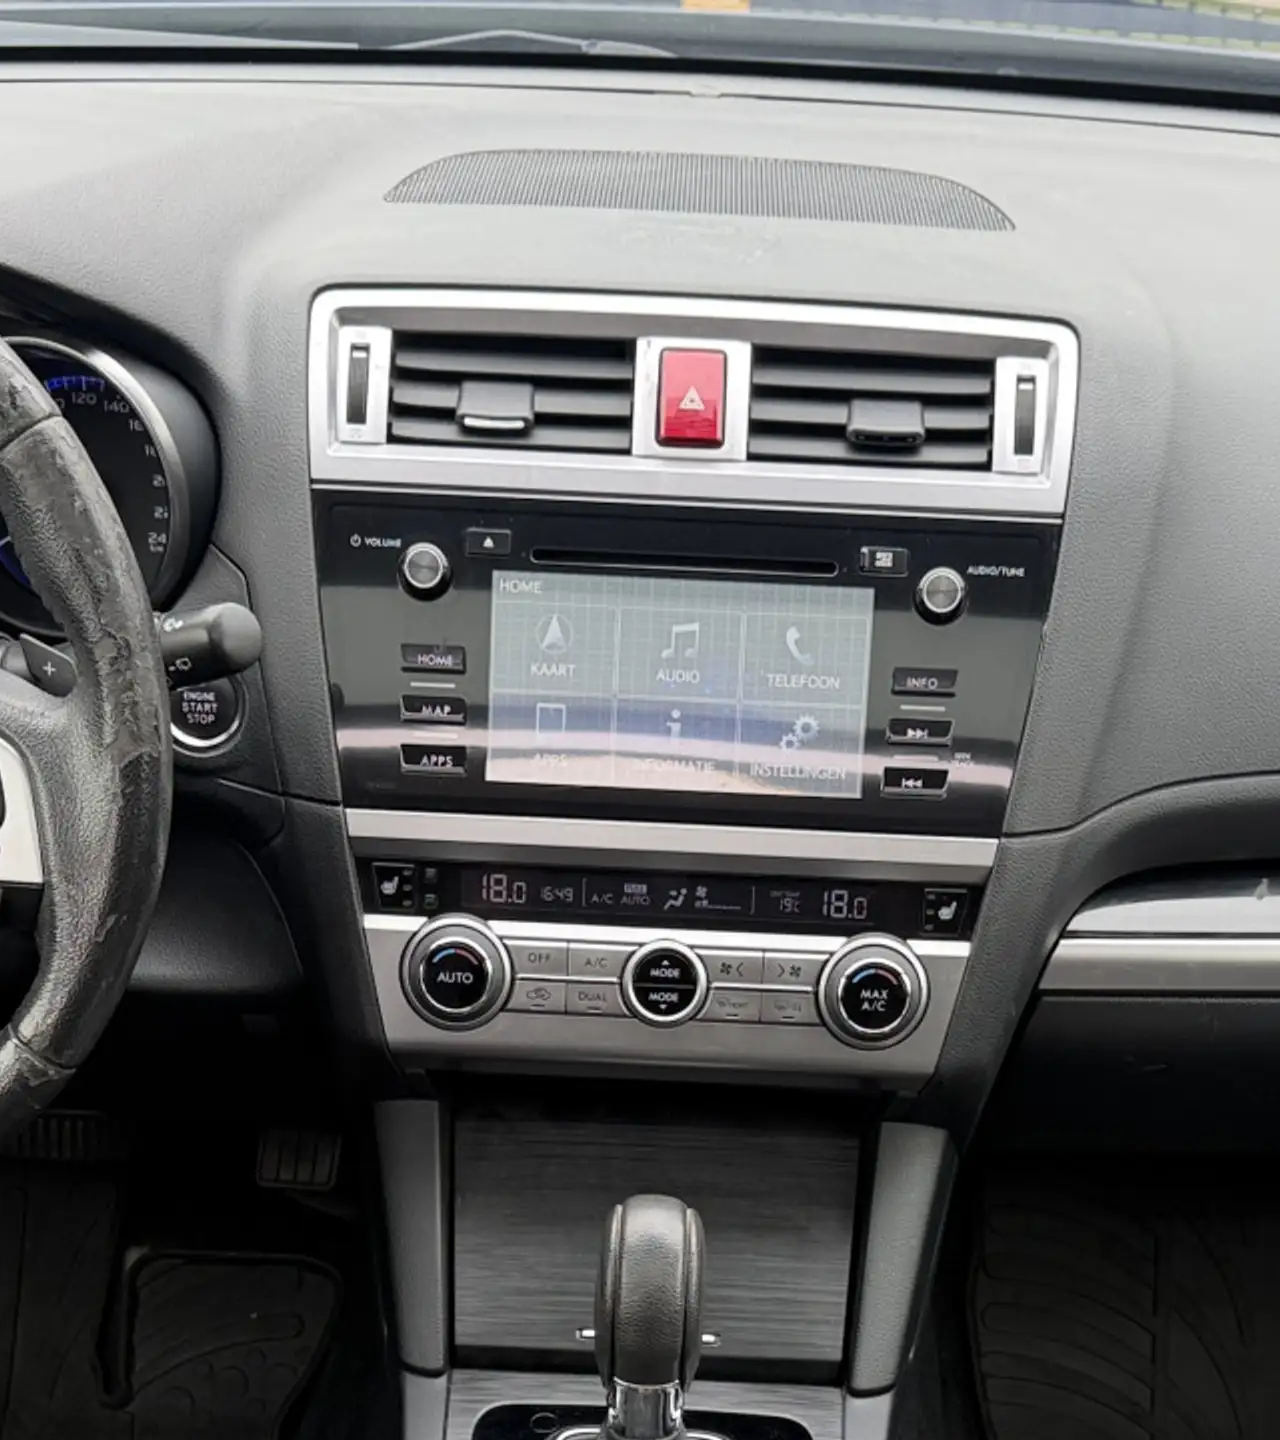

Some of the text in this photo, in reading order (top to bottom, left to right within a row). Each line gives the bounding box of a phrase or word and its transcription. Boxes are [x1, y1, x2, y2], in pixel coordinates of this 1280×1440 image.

[72, 392, 96, 404] 120
[364, 537, 402, 548] VOLUME
[967, 565, 1025, 578] AUDIO/TUNE
[500, 579, 542, 594] HOME
[418, 654, 453, 667] HOME
[530, 663, 576, 678] KAART
[656, 669, 700, 684] AUDIO
[767, 674, 840, 690] TELEFOON
[906, 678, 938, 689] INFO
[183, 690, 215, 701] ENGINE
[182, 702, 218, 714] START
[422, 704, 451, 716] MAP
[186, 714, 216, 725] STOP
[420, 754, 453, 767] APPS
[750, 762, 846, 780] INSTELLINGEN
[482, 874, 613, 904] 18.0 16:49 A/C
[621, 895, 651, 905] AUTO
[823, 890, 867, 919] 18.0
[528, 952, 551, 963] OFF
[584, 957, 609, 969] A/C
[437, 971, 473, 984] AUTO
[650, 967, 680, 979] MODE
[578, 991, 608, 1002] DUAL
[648, 992, 679, 1003] MODE
[860, 989, 889, 1000] MAX
[861, 1001, 886, 1012] A/C
